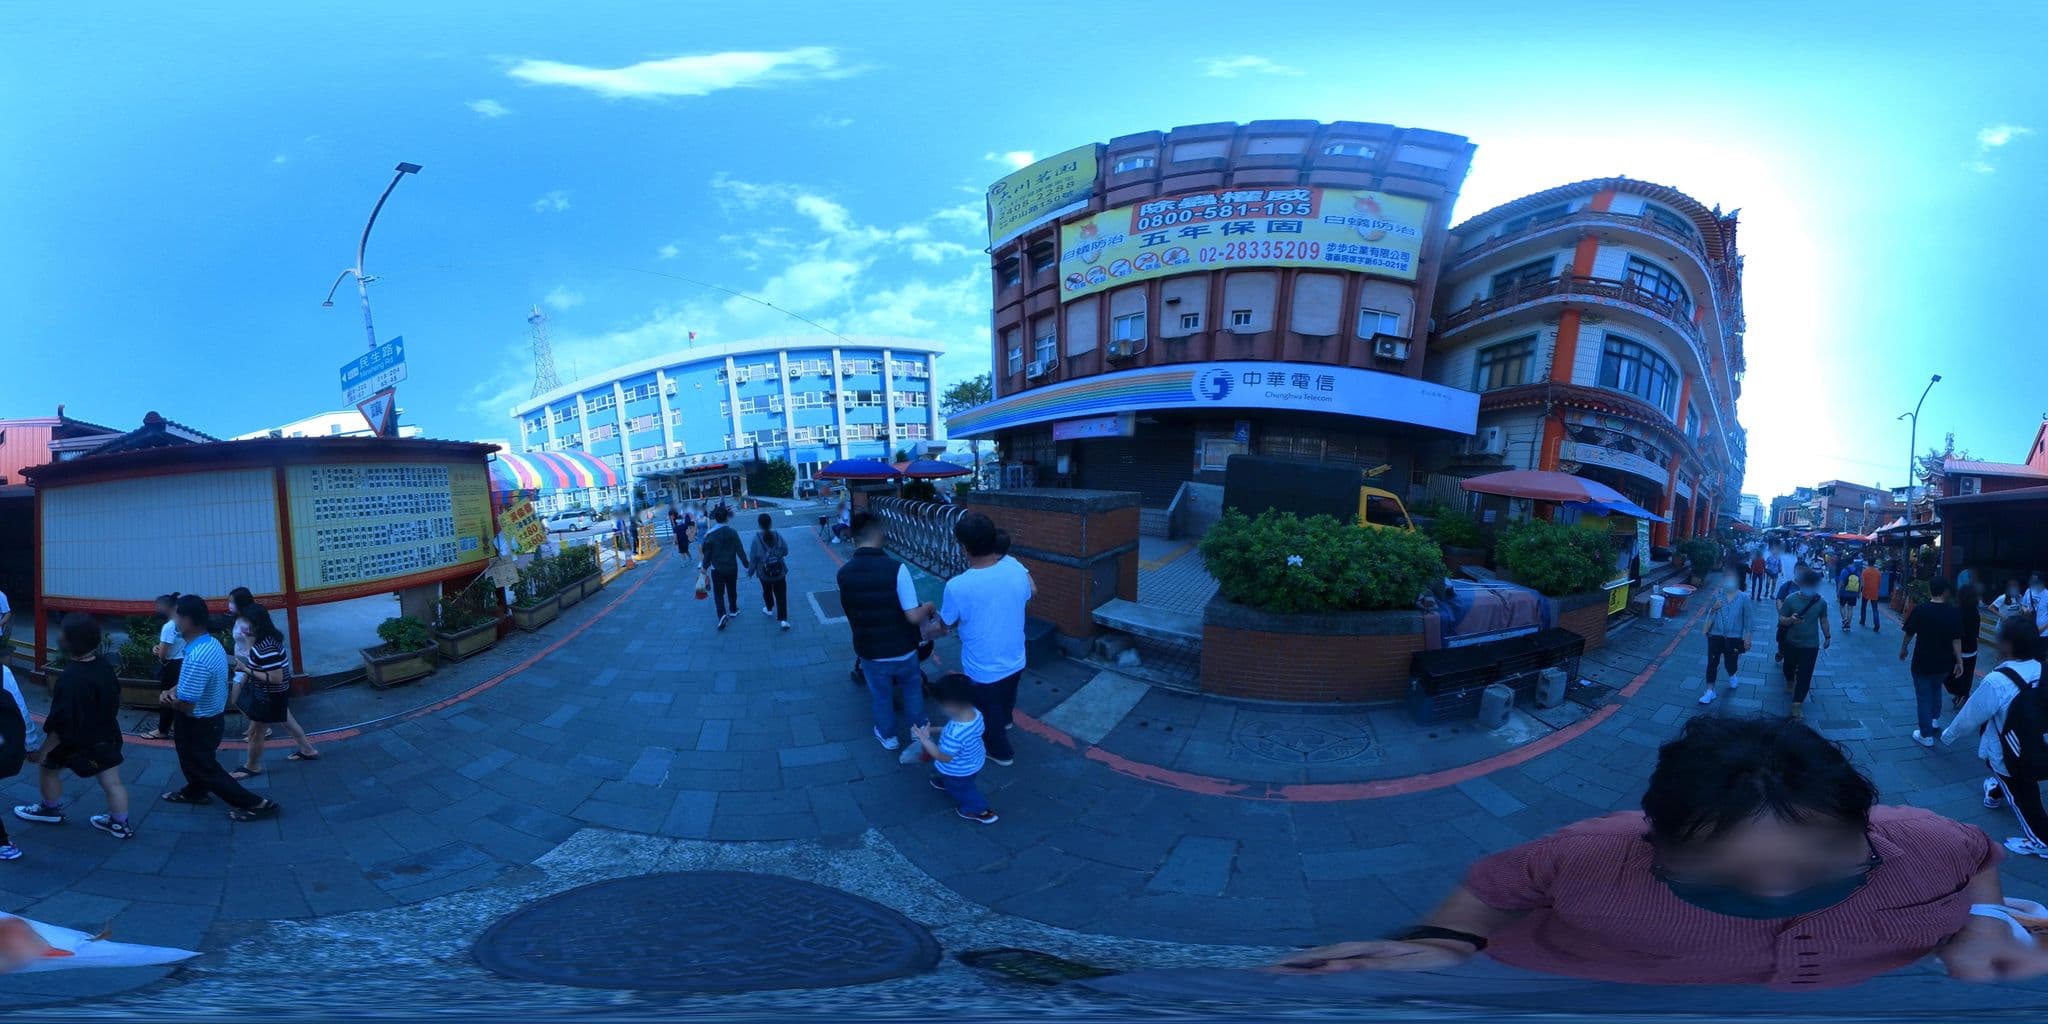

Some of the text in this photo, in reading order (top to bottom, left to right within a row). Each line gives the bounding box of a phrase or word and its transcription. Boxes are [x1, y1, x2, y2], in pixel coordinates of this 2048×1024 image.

[1137, 202, 1311, 231] 0800-581-195
[1324, 215, 1415, 236] 白蟻防治
[1139, 220, 1303, 248] 五年保固
[1063, 233, 1124, 260] 白蟻防治
[1200, 241, 1320, 263] 02-28335209
[1326, 242, 1410, 262] 步步企業有限公司
[360, 343, 393, 369] 民生路
[1242, 371, 1336, 391] 中華電信
[1265, 391, 1333, 402] Chunghwa Telecom
